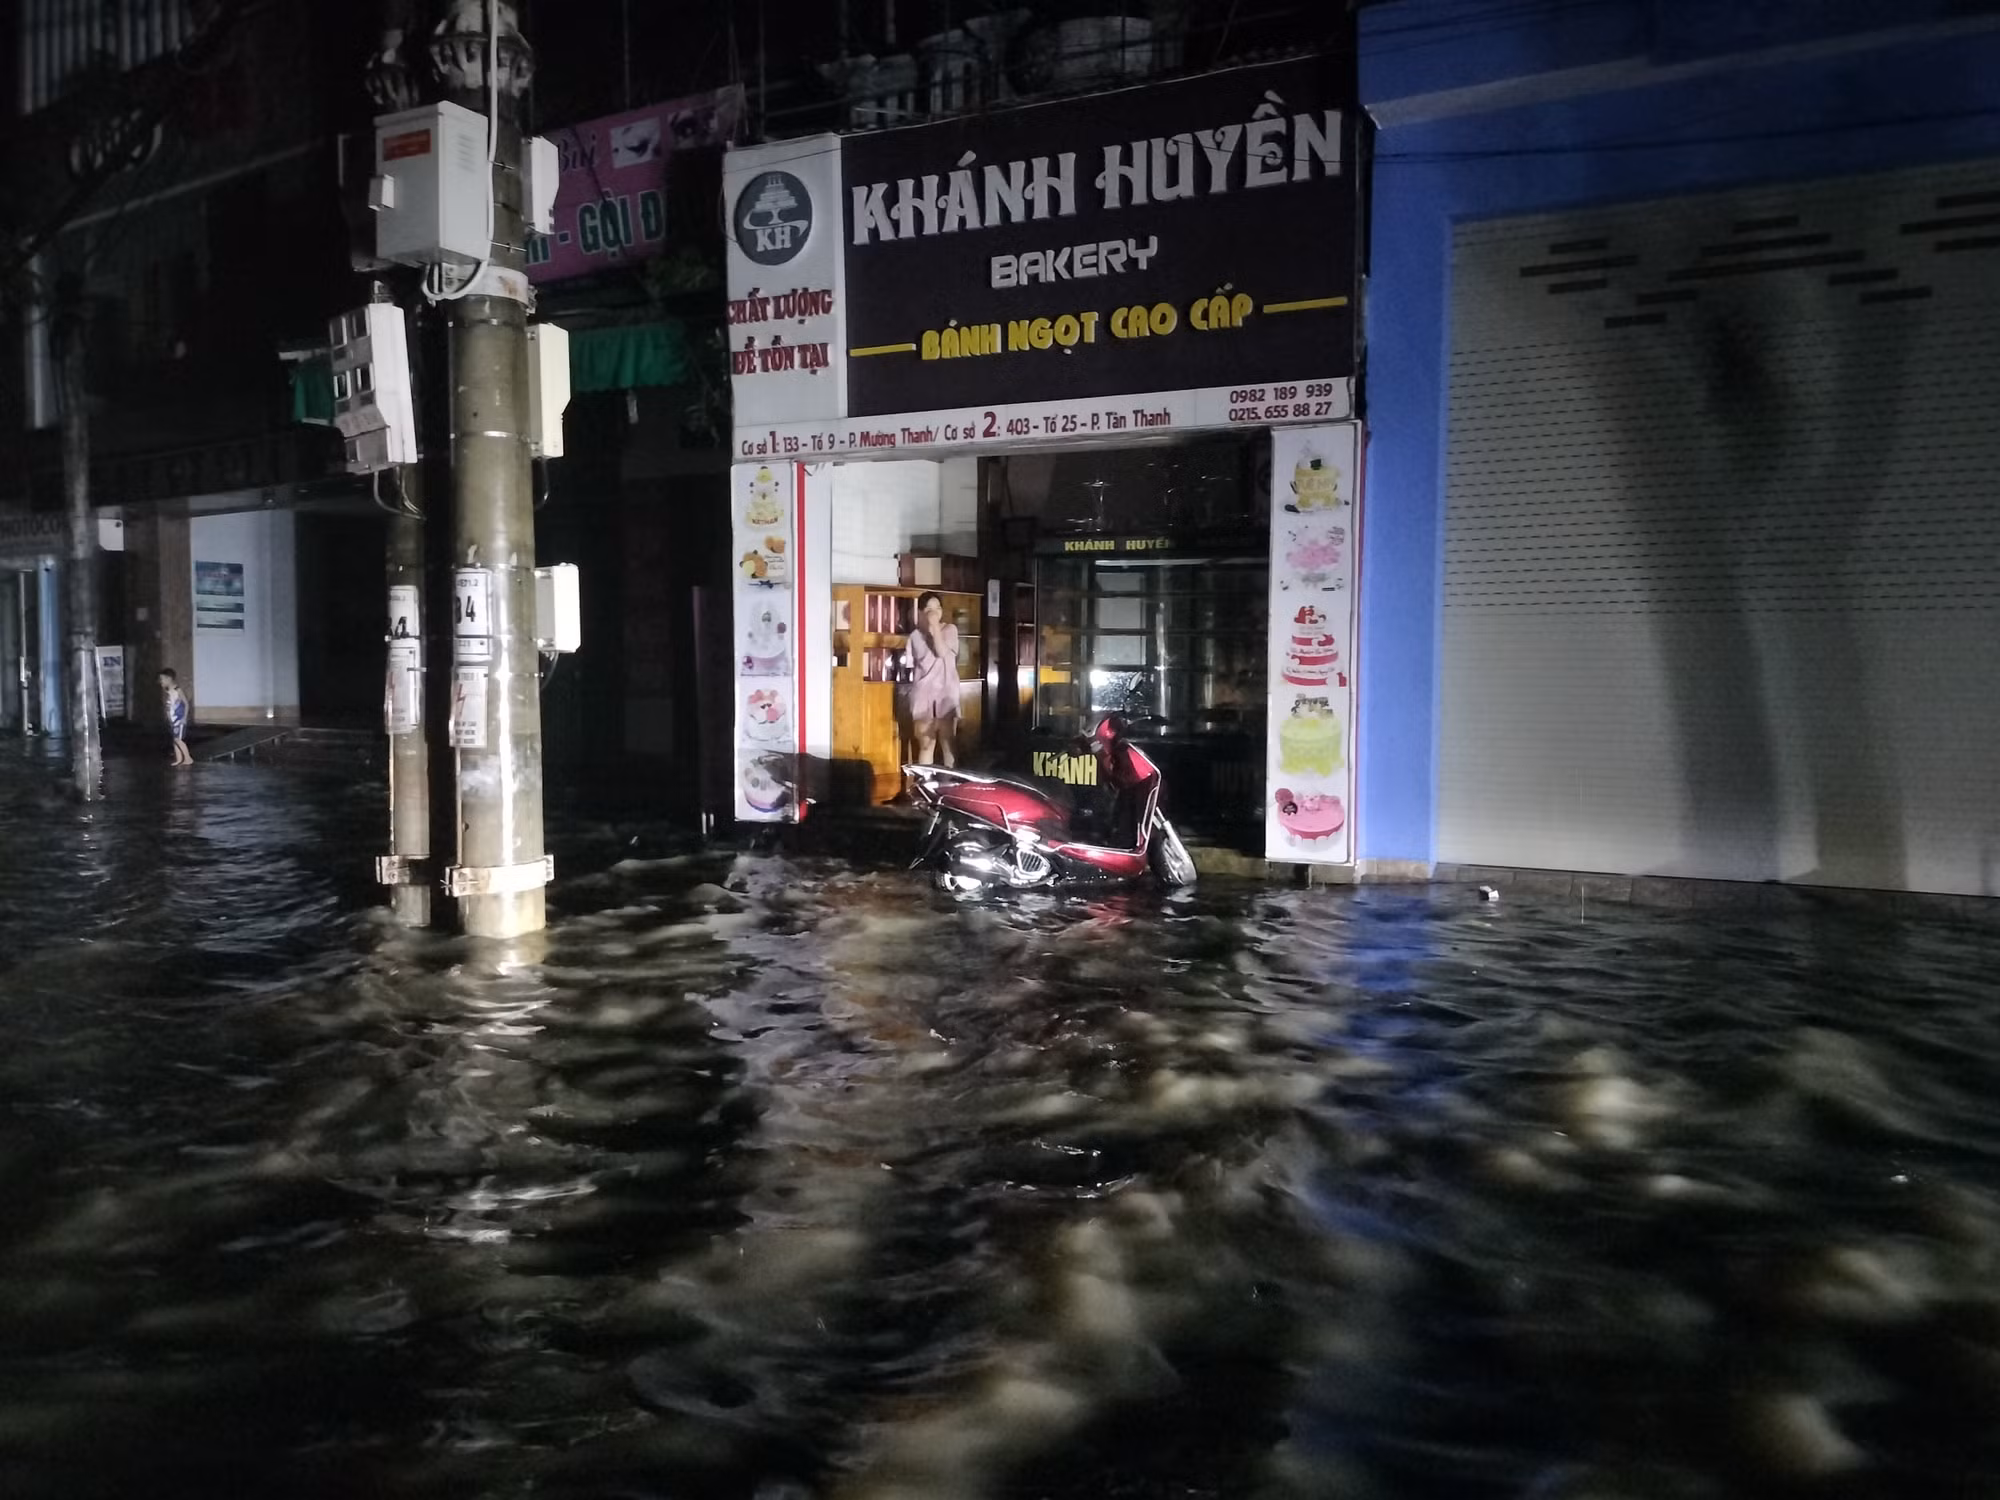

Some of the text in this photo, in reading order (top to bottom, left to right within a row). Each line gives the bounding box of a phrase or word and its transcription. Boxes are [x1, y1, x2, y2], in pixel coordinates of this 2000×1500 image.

[852, 90, 1342, 245] KHÁNH HUYỀN
[756, 226, 791, 252] KH
[991, 236, 1158, 289] BAKERY
[728, 287, 832, 325] CHẤT LƯỢNG
[922, 282, 1254, 360] BÁNH NGỌT CAO CẤP
[798, 342, 829, 375] TẠI
[1230, 383, 1332, 404] 0982 189 939
[1264, 405, 1288, 419] 655
[1293, 403, 1310, 417] 88
[1314, 401, 1332, 416] 27
[783, 436, 799, 453] 133
[828, 433, 836, 450] 9
[1006, 418, 1030, 436] 403
[1061, 415, 1078, 432] 25
[1133, 408, 1171, 427] Thanh
